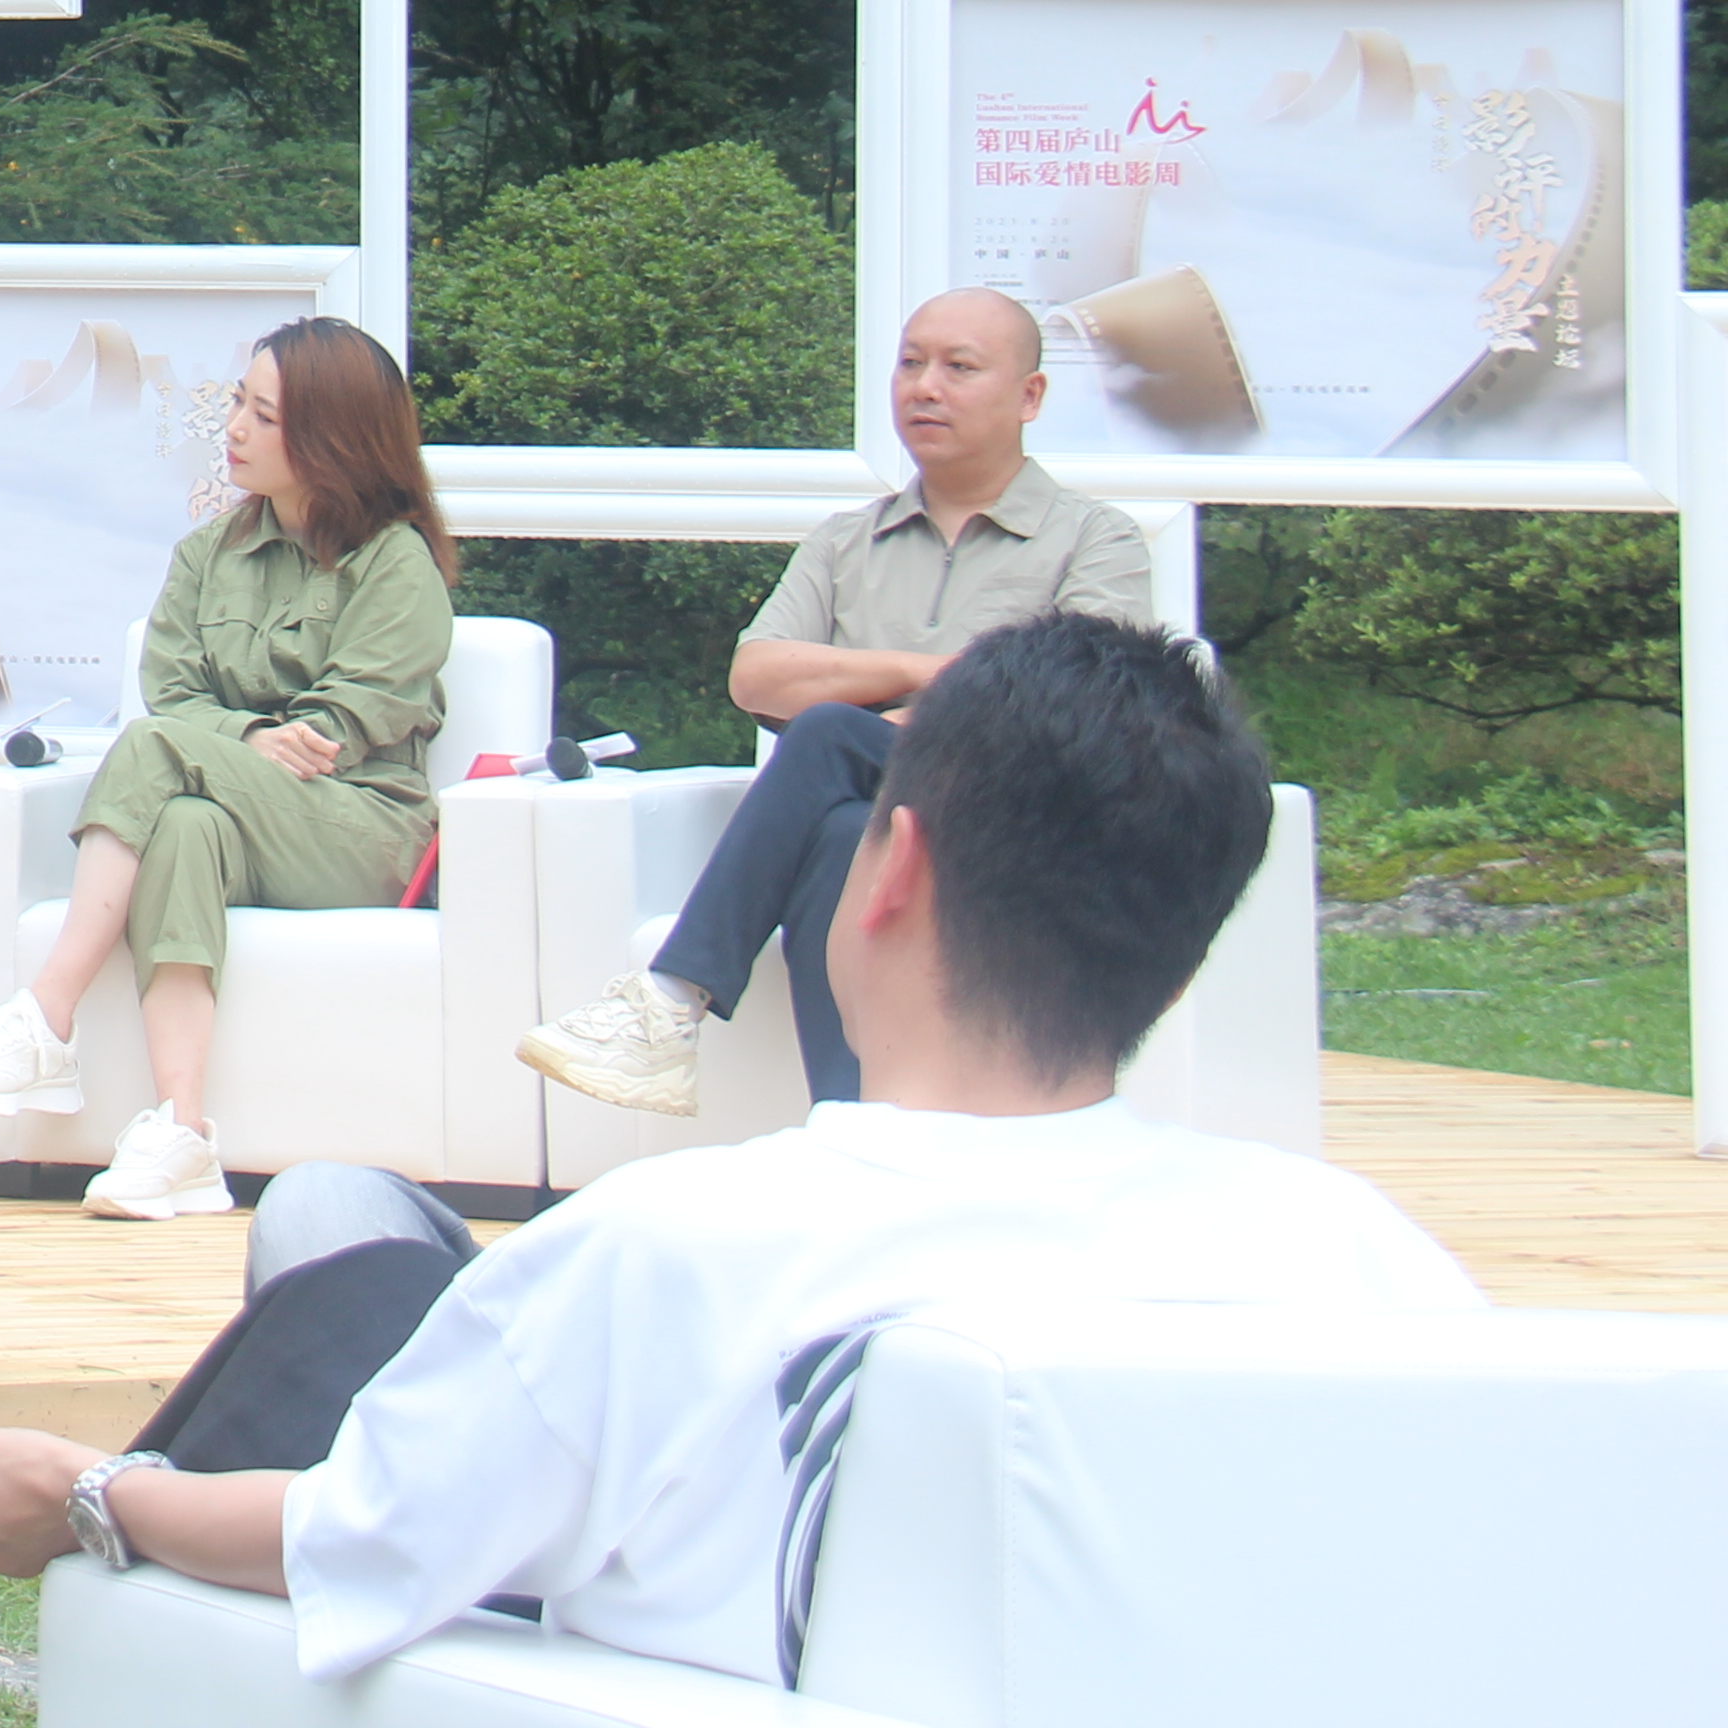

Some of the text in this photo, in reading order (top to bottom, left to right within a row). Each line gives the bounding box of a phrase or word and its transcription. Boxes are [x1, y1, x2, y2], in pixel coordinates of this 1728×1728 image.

[975, 127, 1120, 154] 第四届庐山
[975, 160, 1180, 187] 国际爱情电影周
[1461, 90, 1563, 353] 影评的力量
[1553, 274, 1581, 369] 主题论坛
